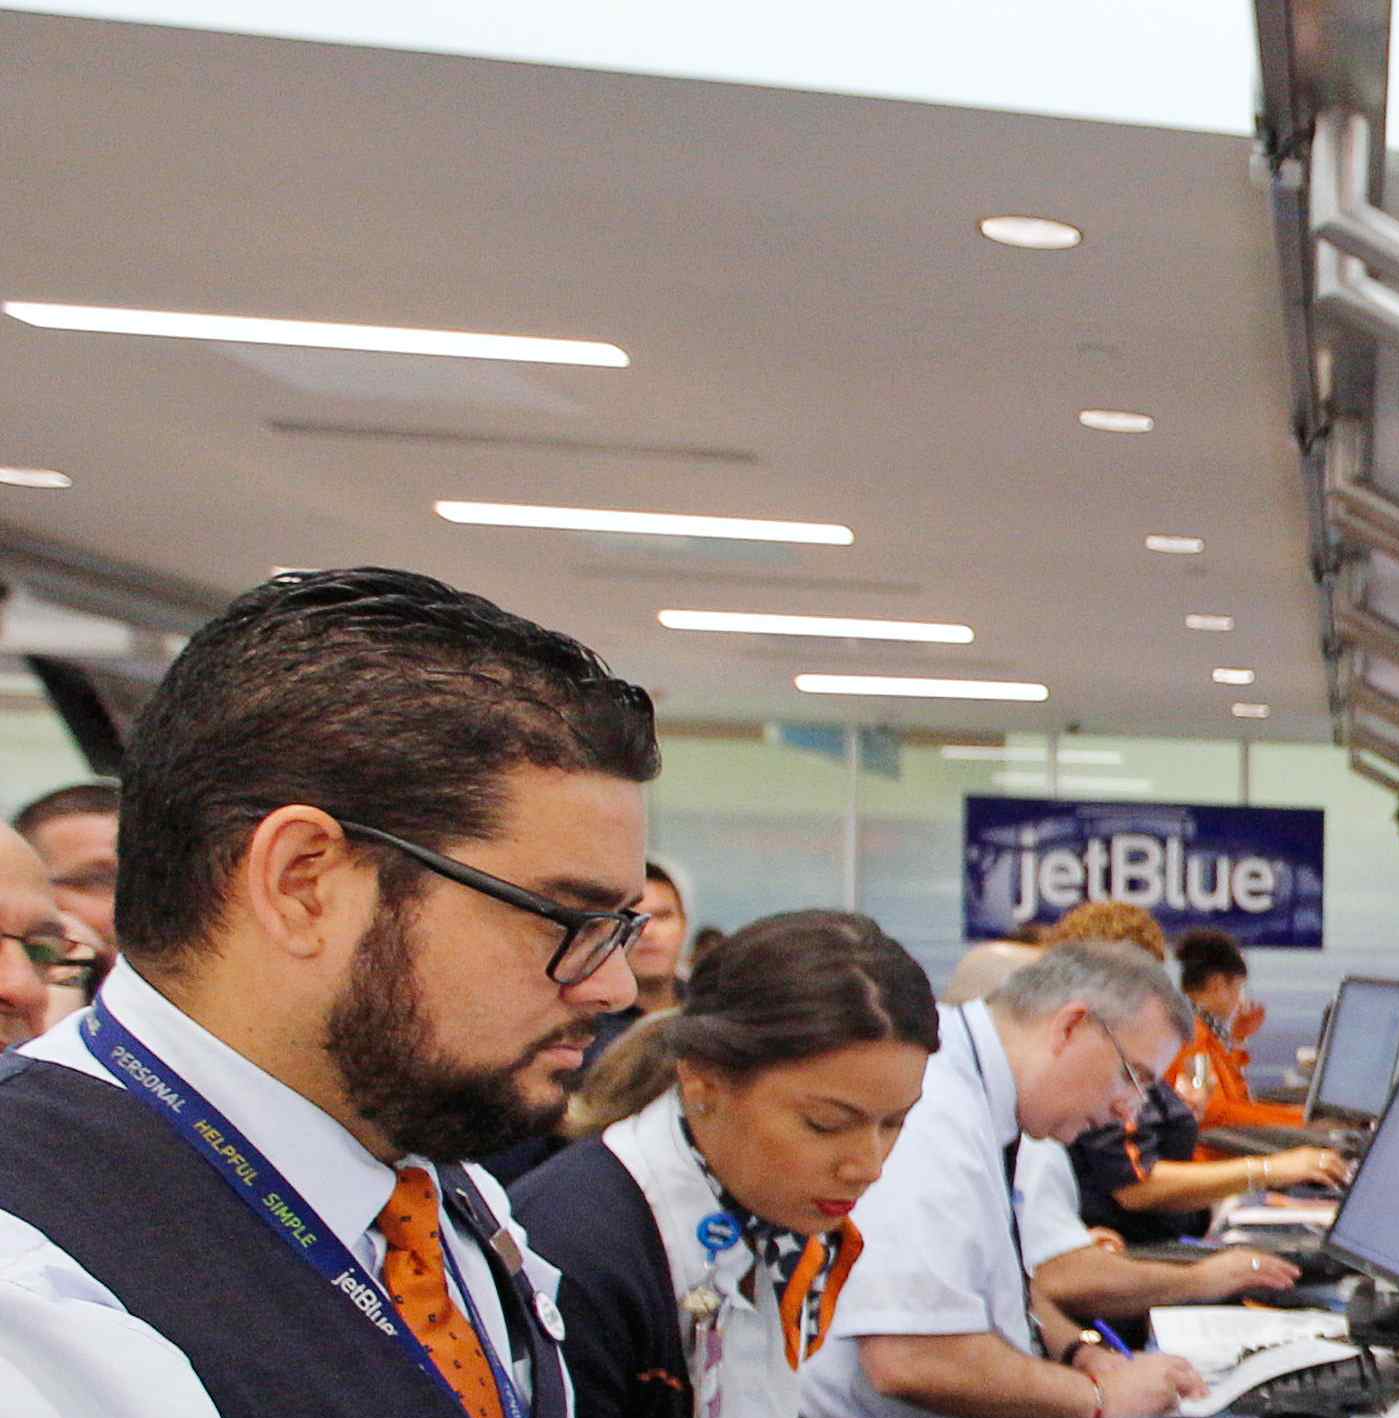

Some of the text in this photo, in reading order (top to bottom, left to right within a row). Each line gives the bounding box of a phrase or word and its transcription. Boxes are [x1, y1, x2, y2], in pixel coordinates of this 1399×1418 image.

[1011, 830, 1278, 919] jetBlue
[110, 1045, 399, 1337] PERSONAL HELPFUL SIMPLE jetBlue
